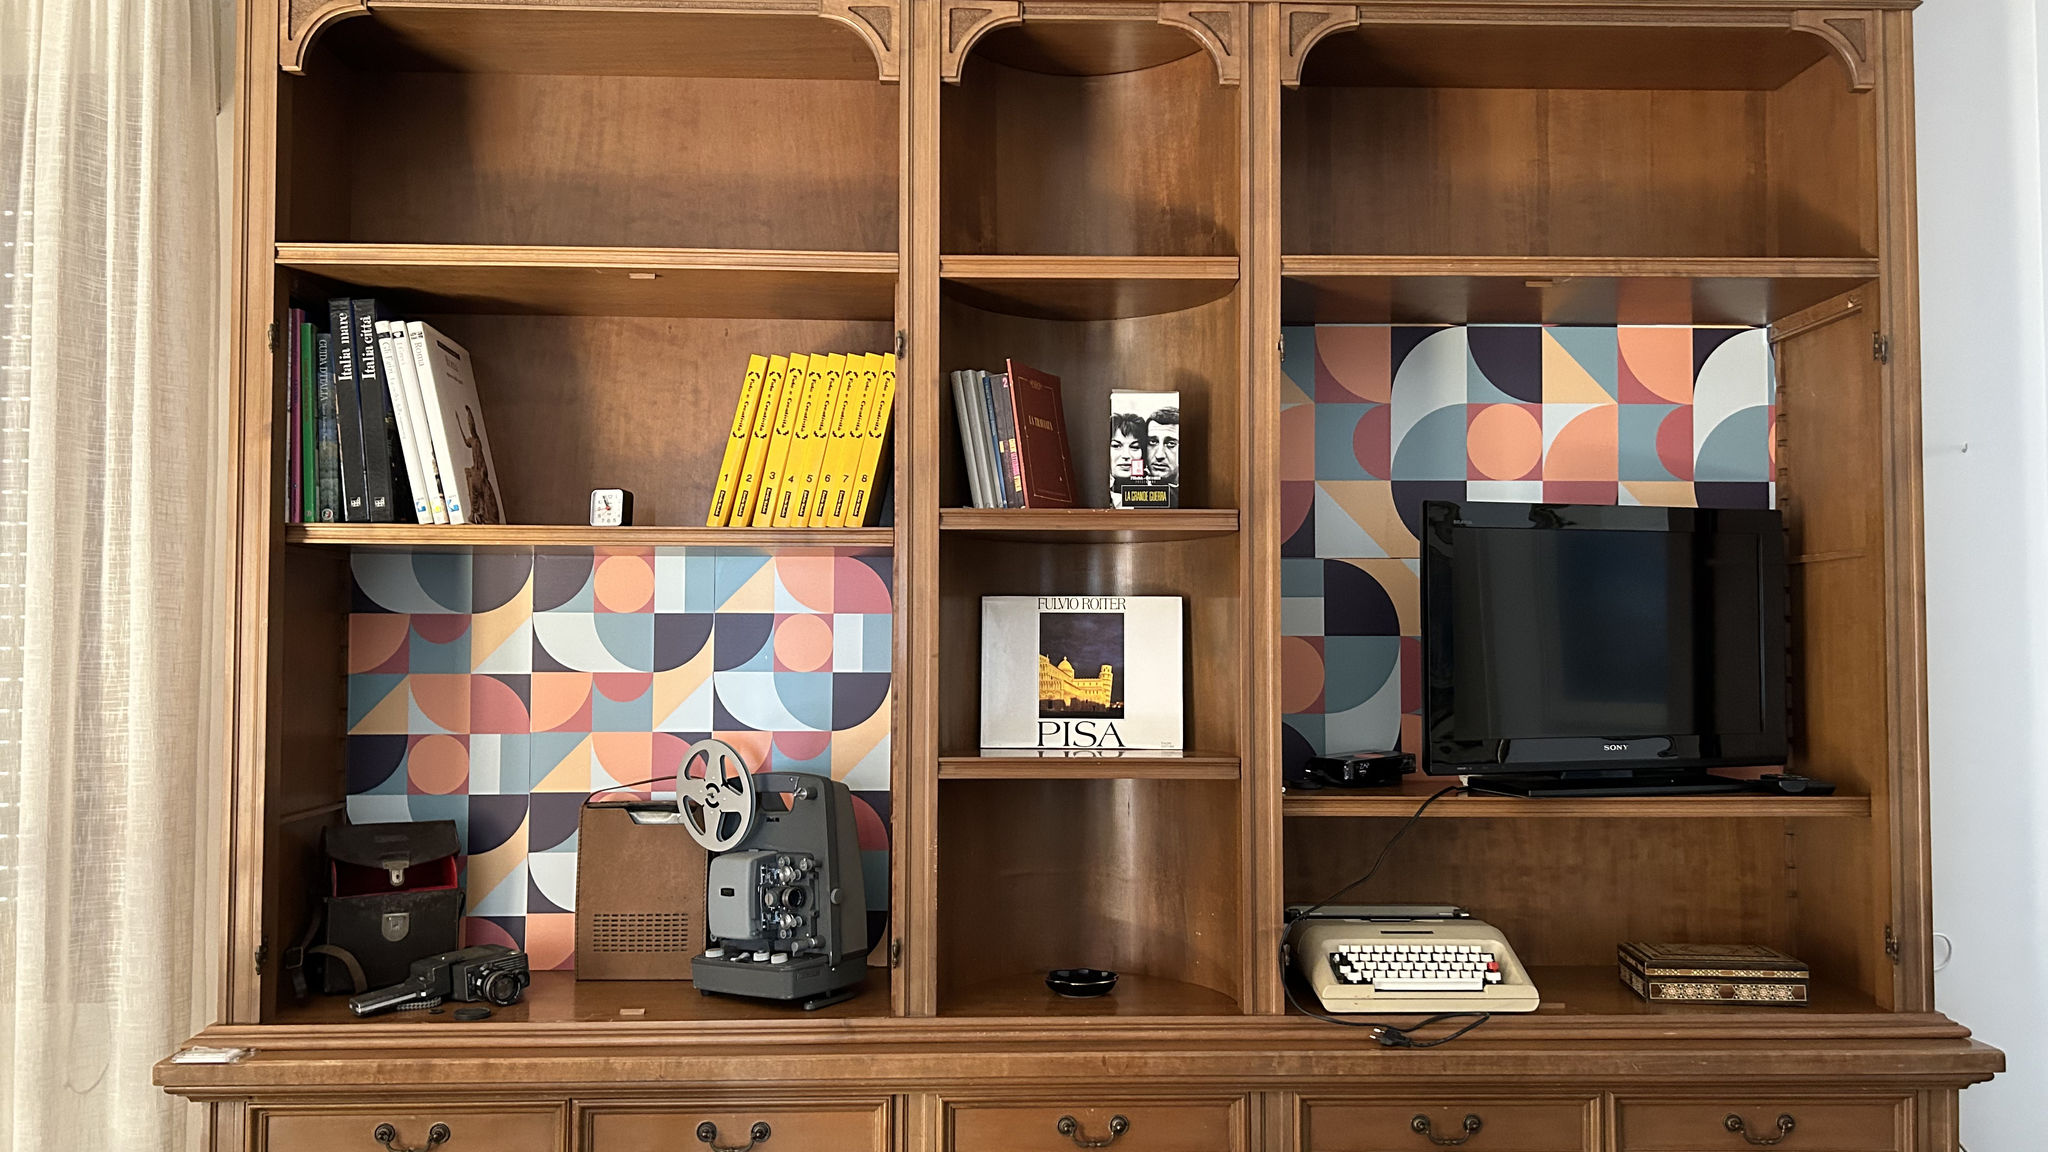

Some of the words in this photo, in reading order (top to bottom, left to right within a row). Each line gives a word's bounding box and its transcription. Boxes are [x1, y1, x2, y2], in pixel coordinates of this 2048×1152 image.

[339, 312, 350, 345] mare
[318, 339, 328, 365] GUIDA
[414, 342, 425, 367] Roma
[338, 348, 353, 380] Italia
[361, 345, 376, 380] Italia
[1002, 377, 1008, 388] 2
[746, 474, 752, 482] 2
[769, 471, 775, 479] 3
[806, 474, 813, 482] 5
[824, 474, 831, 482] 6
[861, 474, 868, 482] 8
[1125, 491, 1130, 501] LA
[1131, 491, 1148, 501] GRANDE
[1149, 491, 1166, 501] GUERRA
[1038, 597, 1079, 610] FULVIO
[1082, 597, 1126, 610] ROITER
[1037, 721, 1126, 747] PISA
